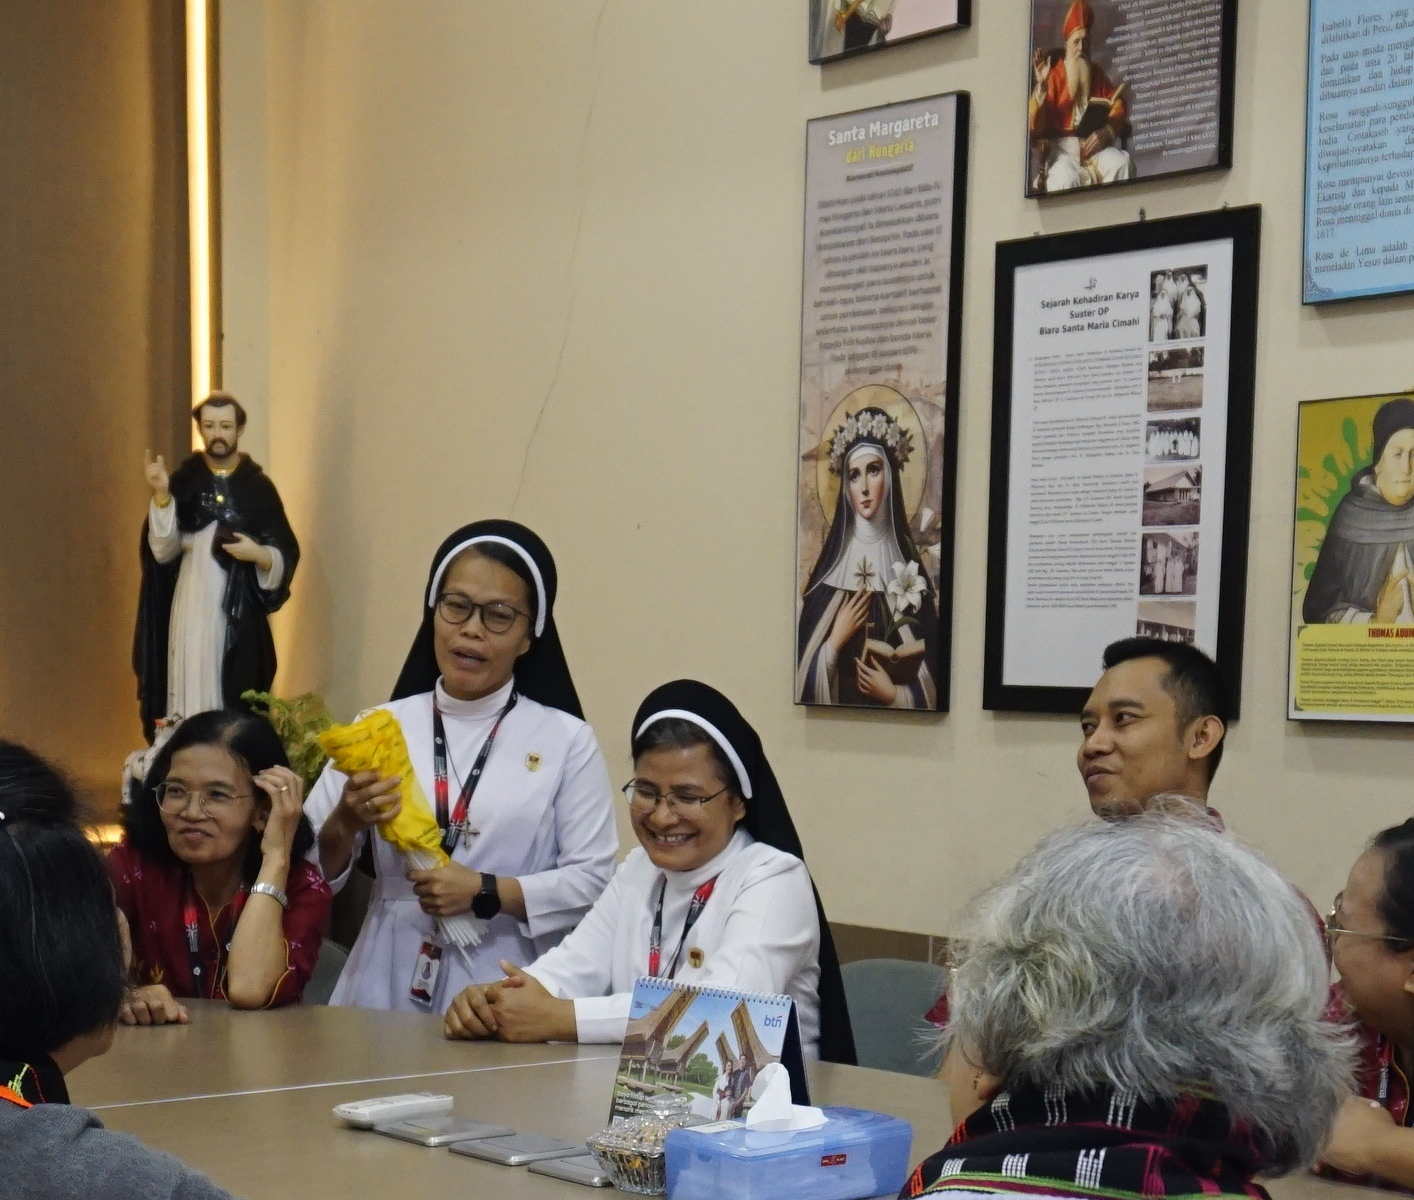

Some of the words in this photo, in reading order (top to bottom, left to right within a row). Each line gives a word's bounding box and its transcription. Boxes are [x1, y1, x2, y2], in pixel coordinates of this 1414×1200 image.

[828, 125, 866, 146] Santa
[868, 111, 939, 138] Margareta
[1041, 297, 1070, 309] Sejarah
[1072, 294, 1113, 304] Kehadiran
[1116, 291, 1139, 300] Karya
[1069, 310, 1095, 318] Suster
[1097, 307, 1109, 315] OP
[1039, 327, 1059, 335] Biara
[1062, 324, 1085, 333] Santa
[1087, 320, 1109, 330] Maria
[1112, 317, 1139, 327] Cimahi
[1368, 628, 1394, 637] THOMAS
